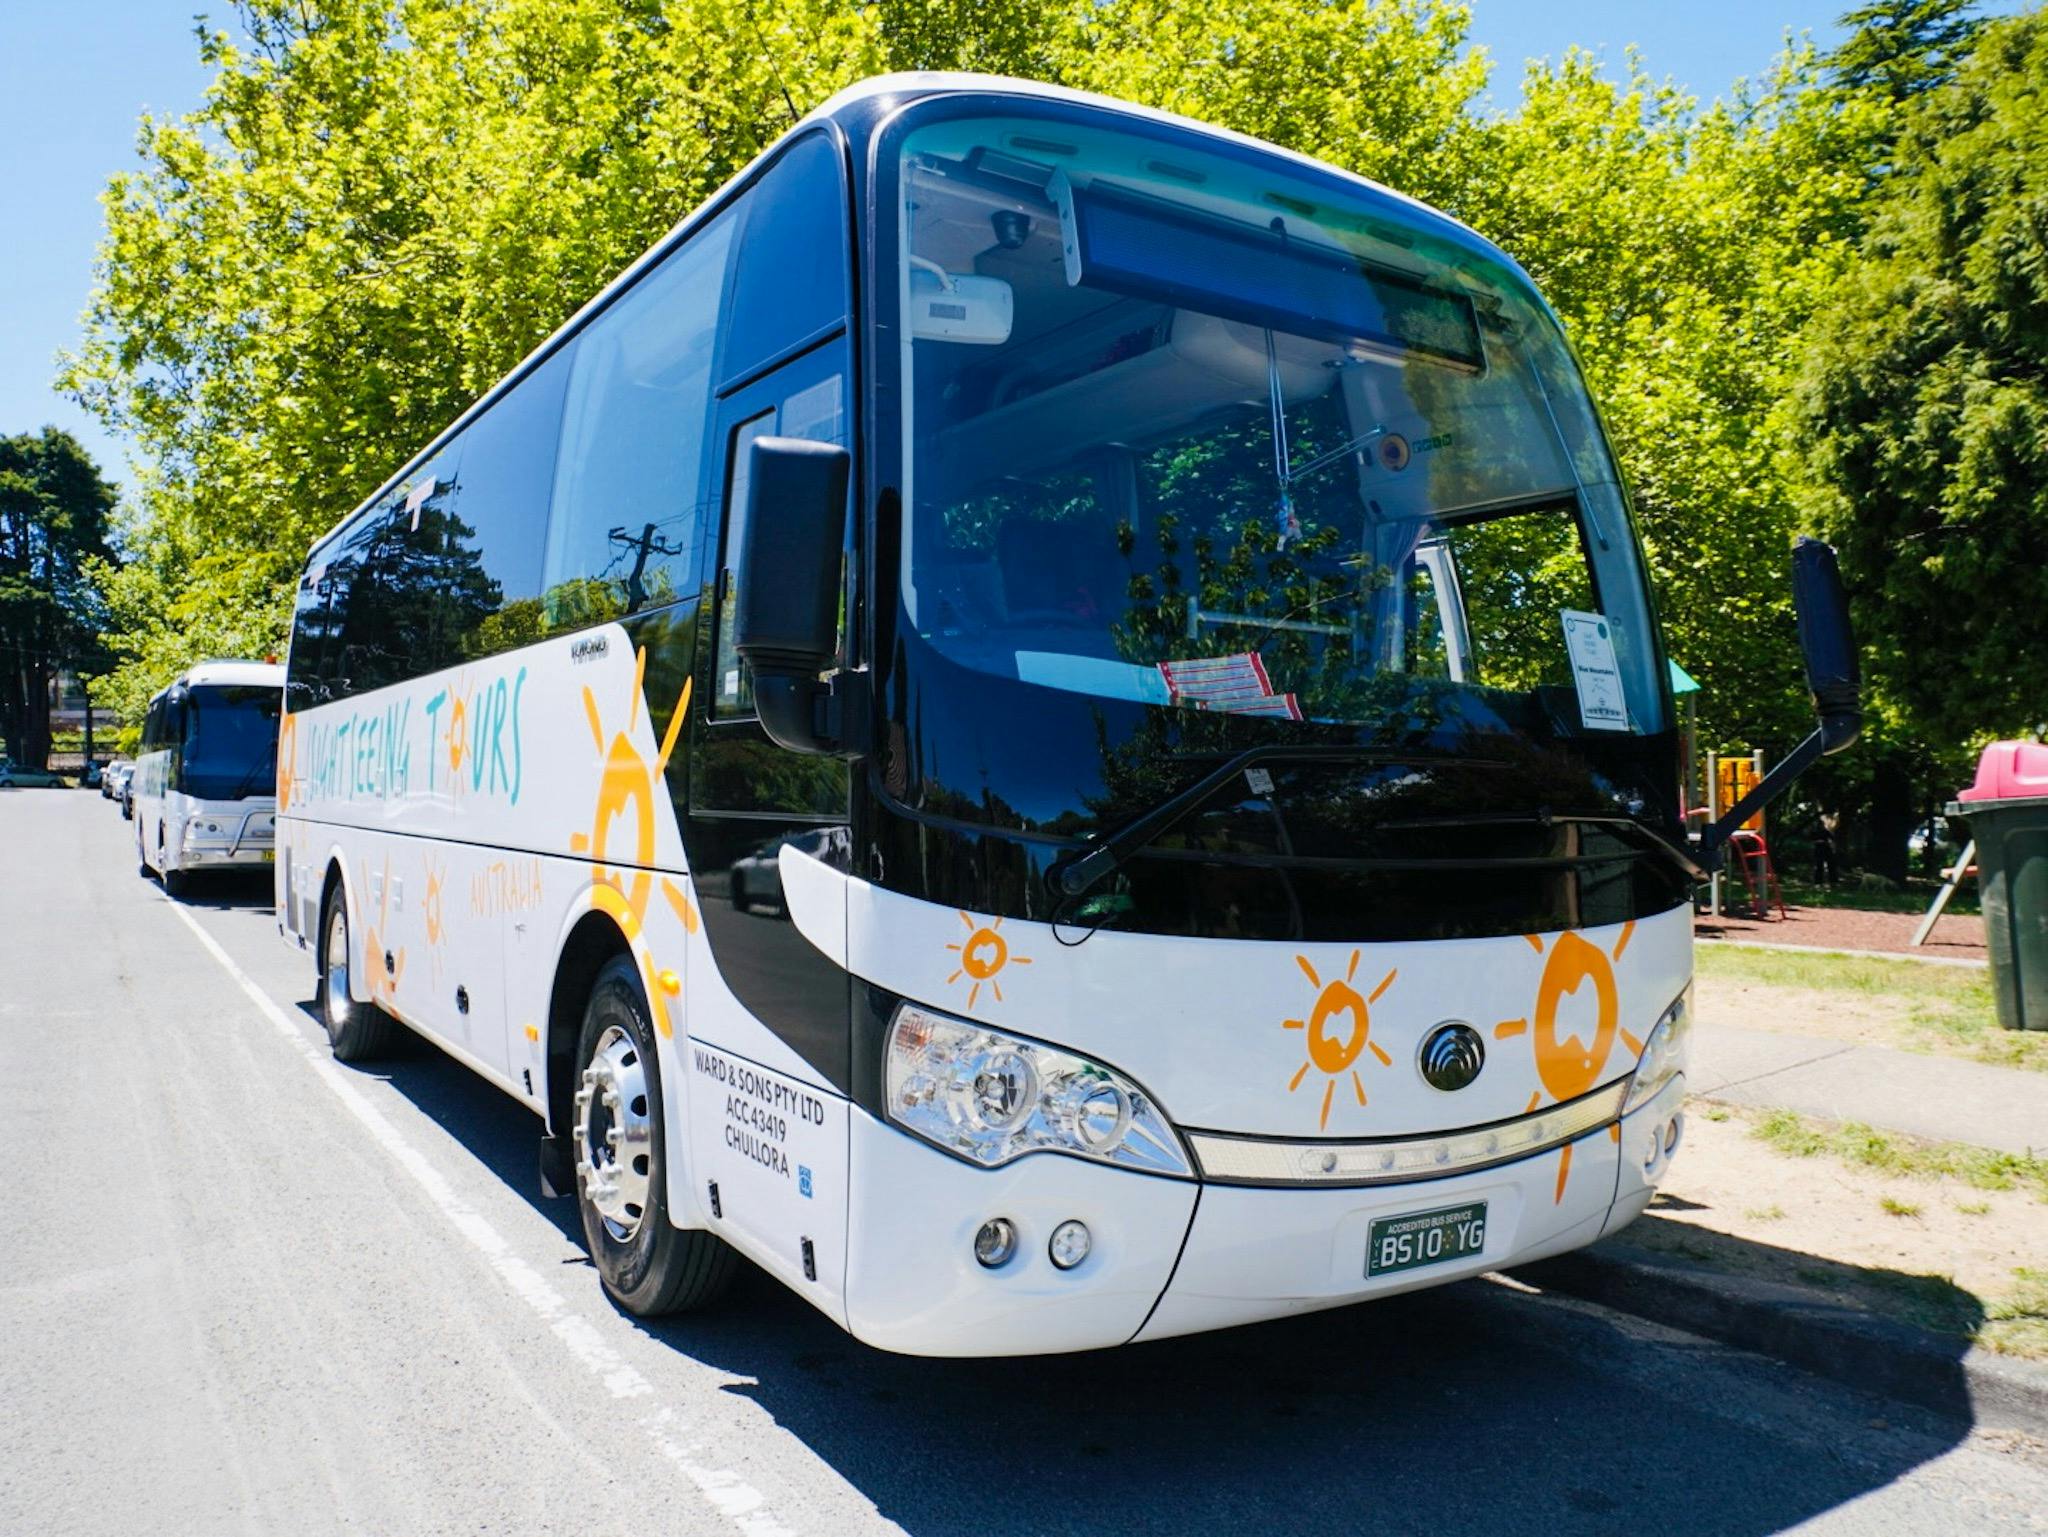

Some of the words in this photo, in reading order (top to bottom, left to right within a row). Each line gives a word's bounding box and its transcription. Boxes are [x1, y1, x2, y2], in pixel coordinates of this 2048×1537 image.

[470, 856, 543, 918] AUSTRALIA
[694, 1048, 726, 1082] WARD
[728, 1065, 737, 1087] &
[738, 1068, 772, 1104] SONS
[774, 1082, 798, 1115] PTY
[801, 1093, 824, 1126] LTD
[725, 1124, 790, 1179] CHULLORA
[1387, 1218, 1431, 1234] ACCREDITED
[1431, 1213, 1445, 1227] BUS
[1446, 1209, 1473, 1223] SERVICE
